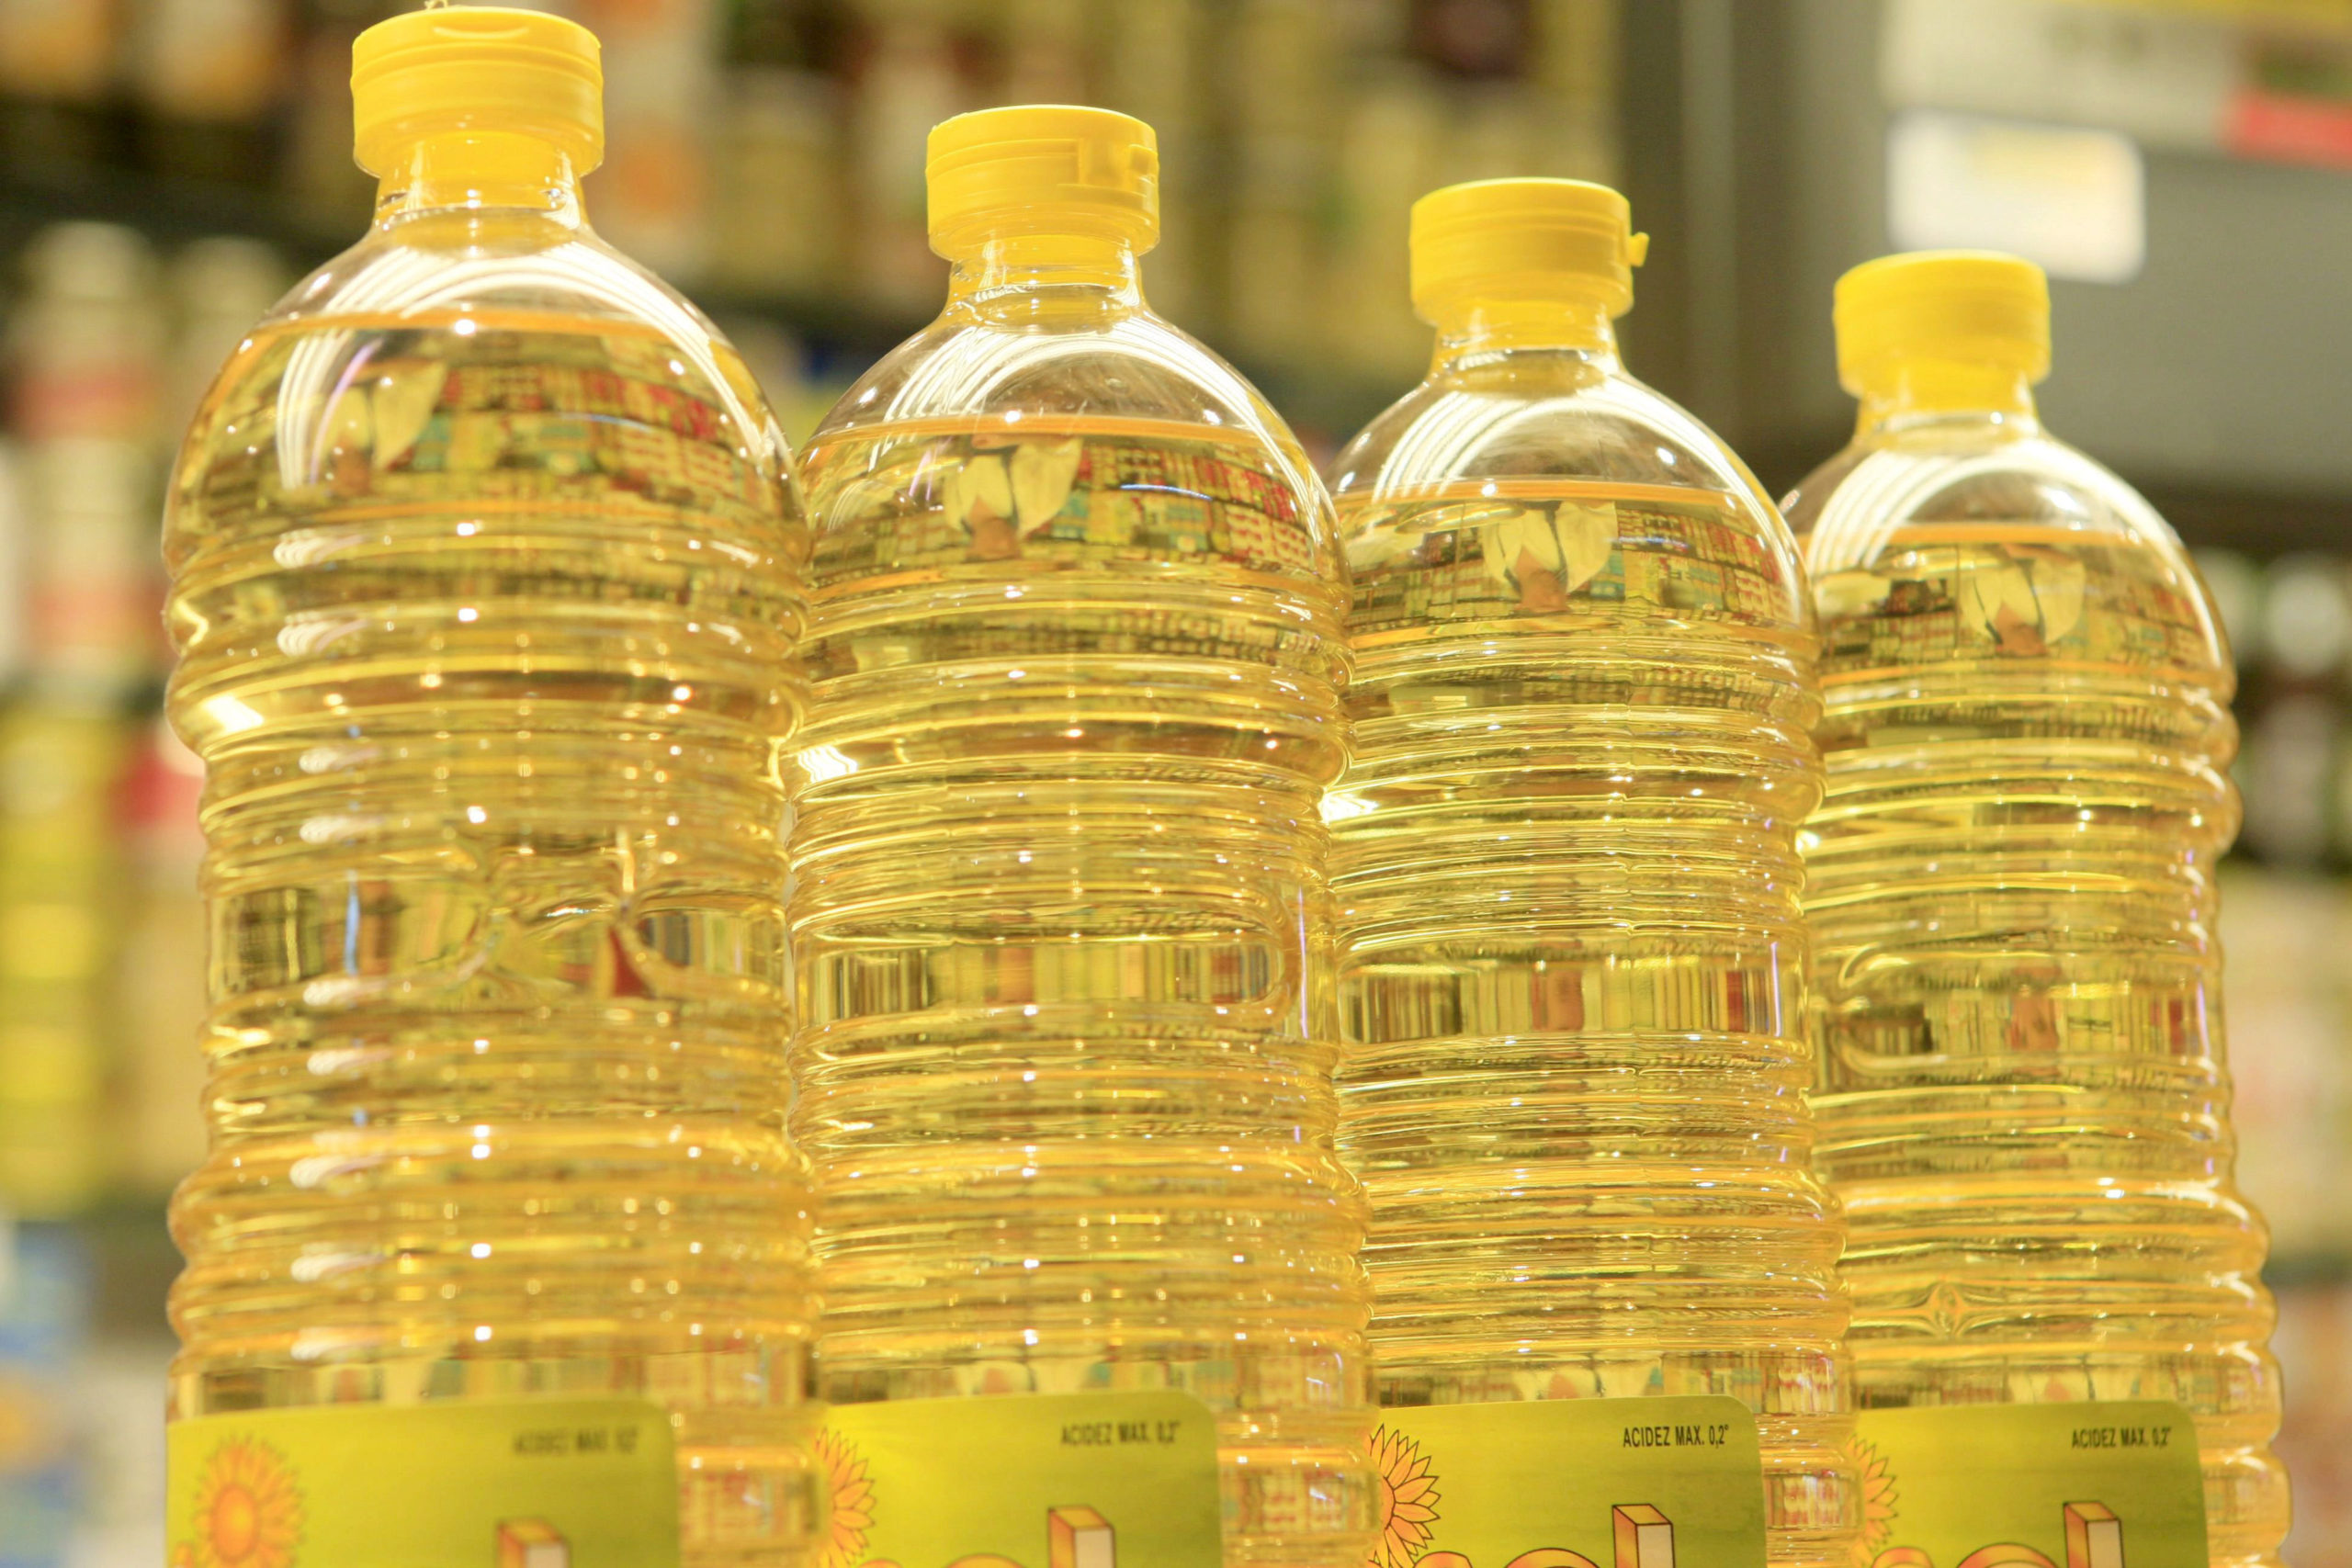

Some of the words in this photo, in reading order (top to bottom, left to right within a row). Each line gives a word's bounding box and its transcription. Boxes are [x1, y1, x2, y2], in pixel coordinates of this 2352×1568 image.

[1623, 1426, 1670, 1448] ACIDEZ
[1675, 1426, 1705, 1446] MAX.
[2072, 1428, 2116, 1448] ACIDEZ
